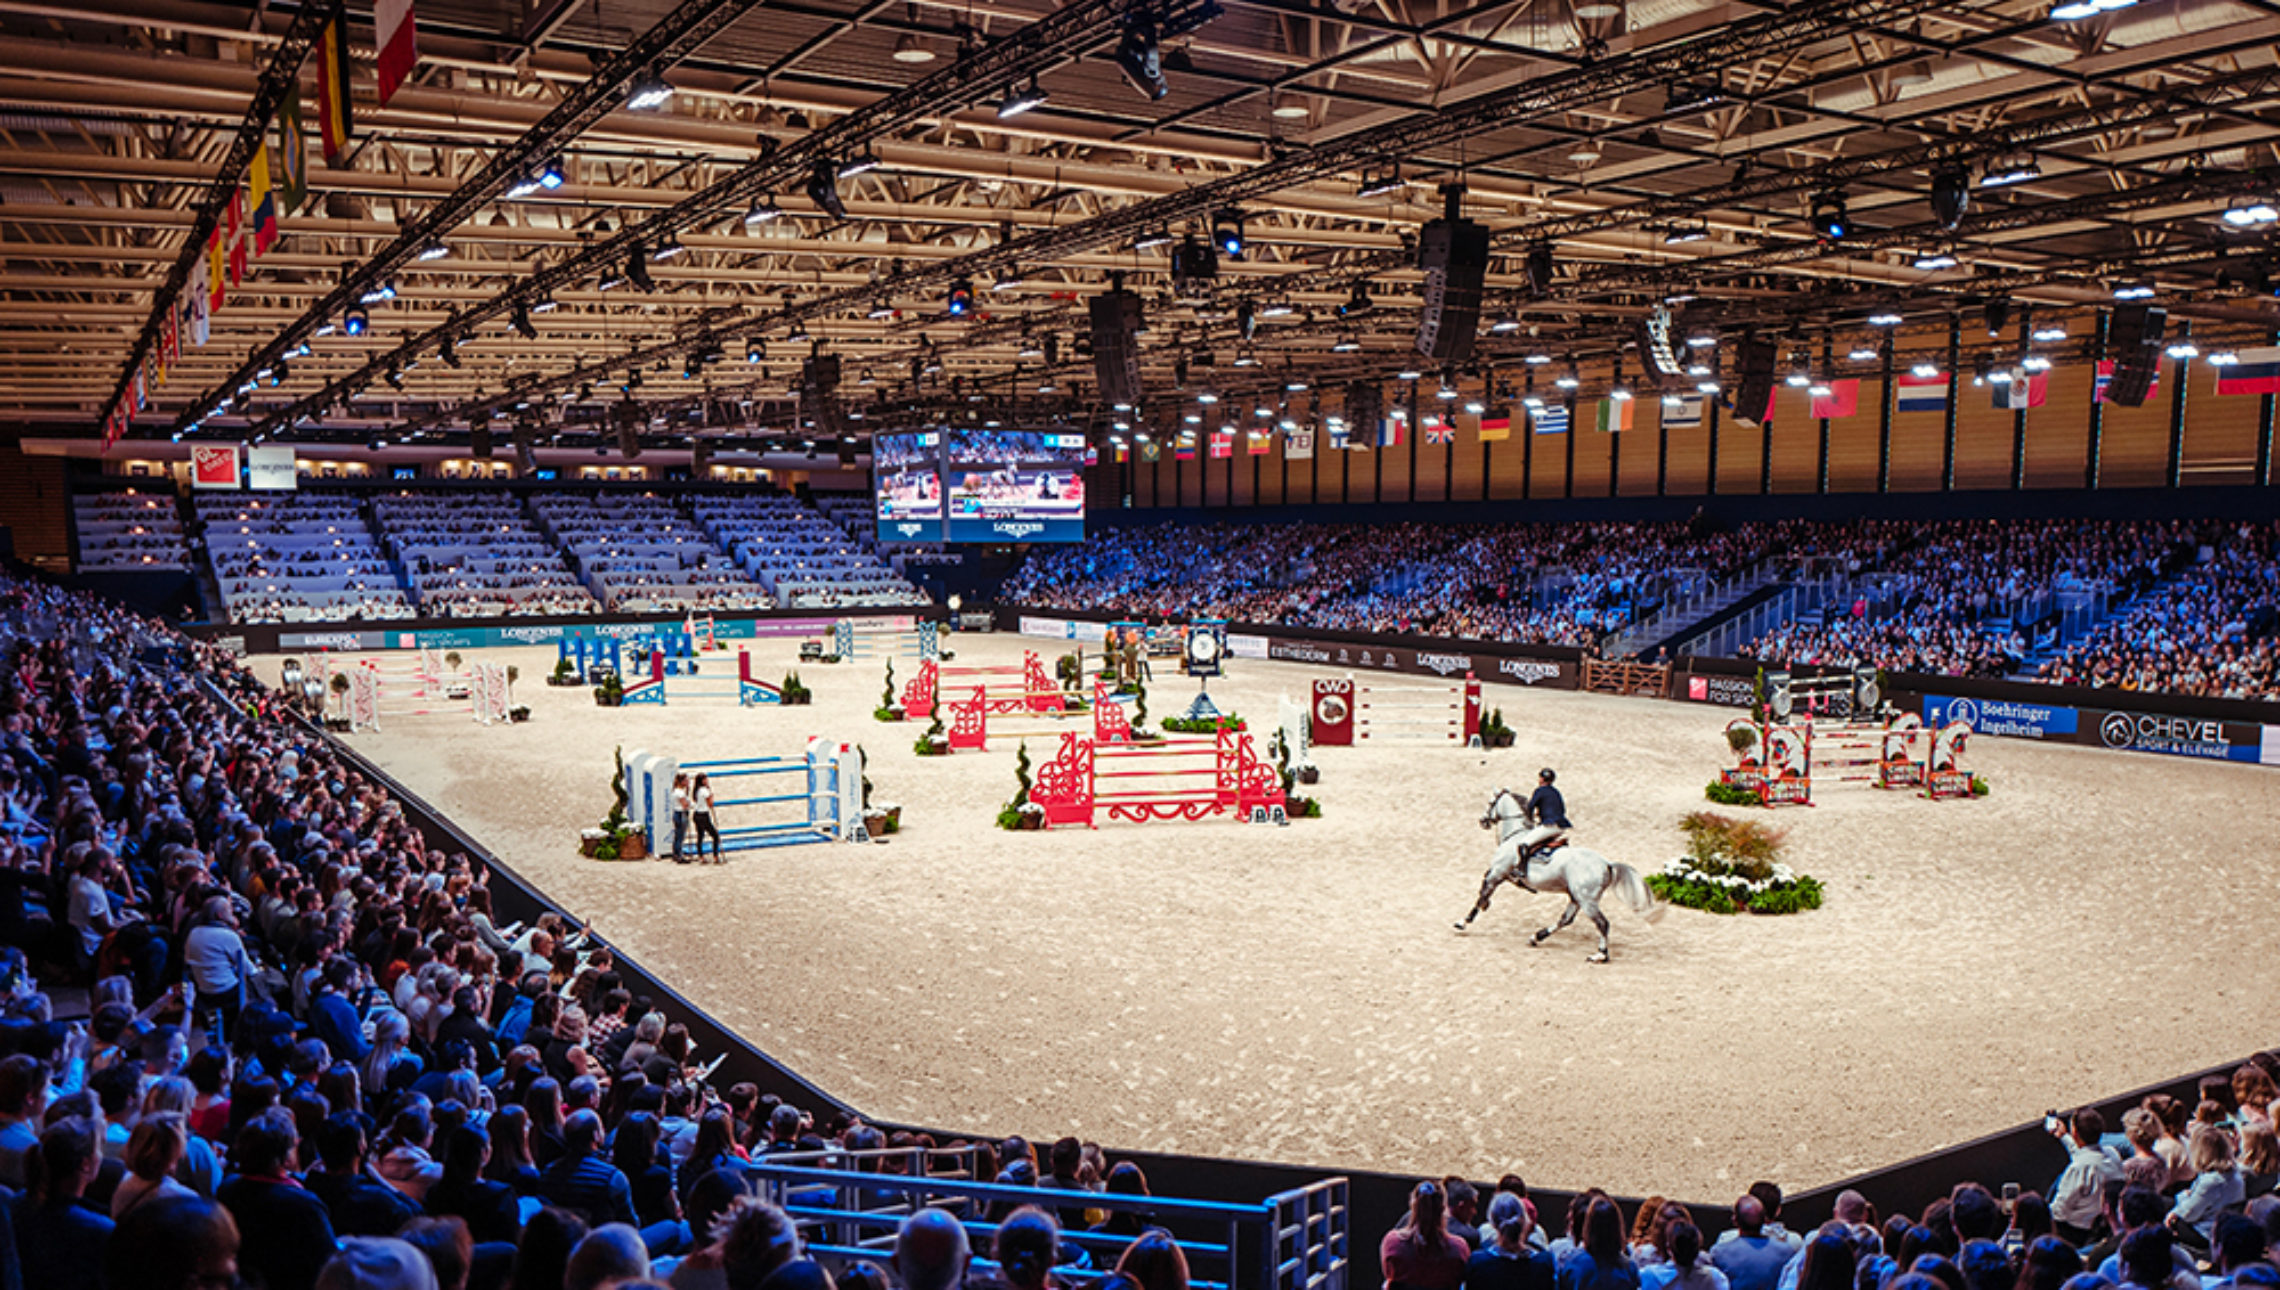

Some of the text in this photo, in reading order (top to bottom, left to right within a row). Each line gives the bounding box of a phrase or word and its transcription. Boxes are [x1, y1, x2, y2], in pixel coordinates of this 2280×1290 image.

[1416, 652, 1471, 669] LONGINES
[1499, 660, 1560, 678] LONGINES
[1709, 678, 1754, 692] PASSION
[1709, 690, 1756, 706] FOR SPO
[1981, 701, 2051, 722] Boehringer
[1981, 717, 2043, 737] Ingelheim
[2137, 715, 2230, 744] CHEVEL
[2136, 739, 2169, 751] SPORT
